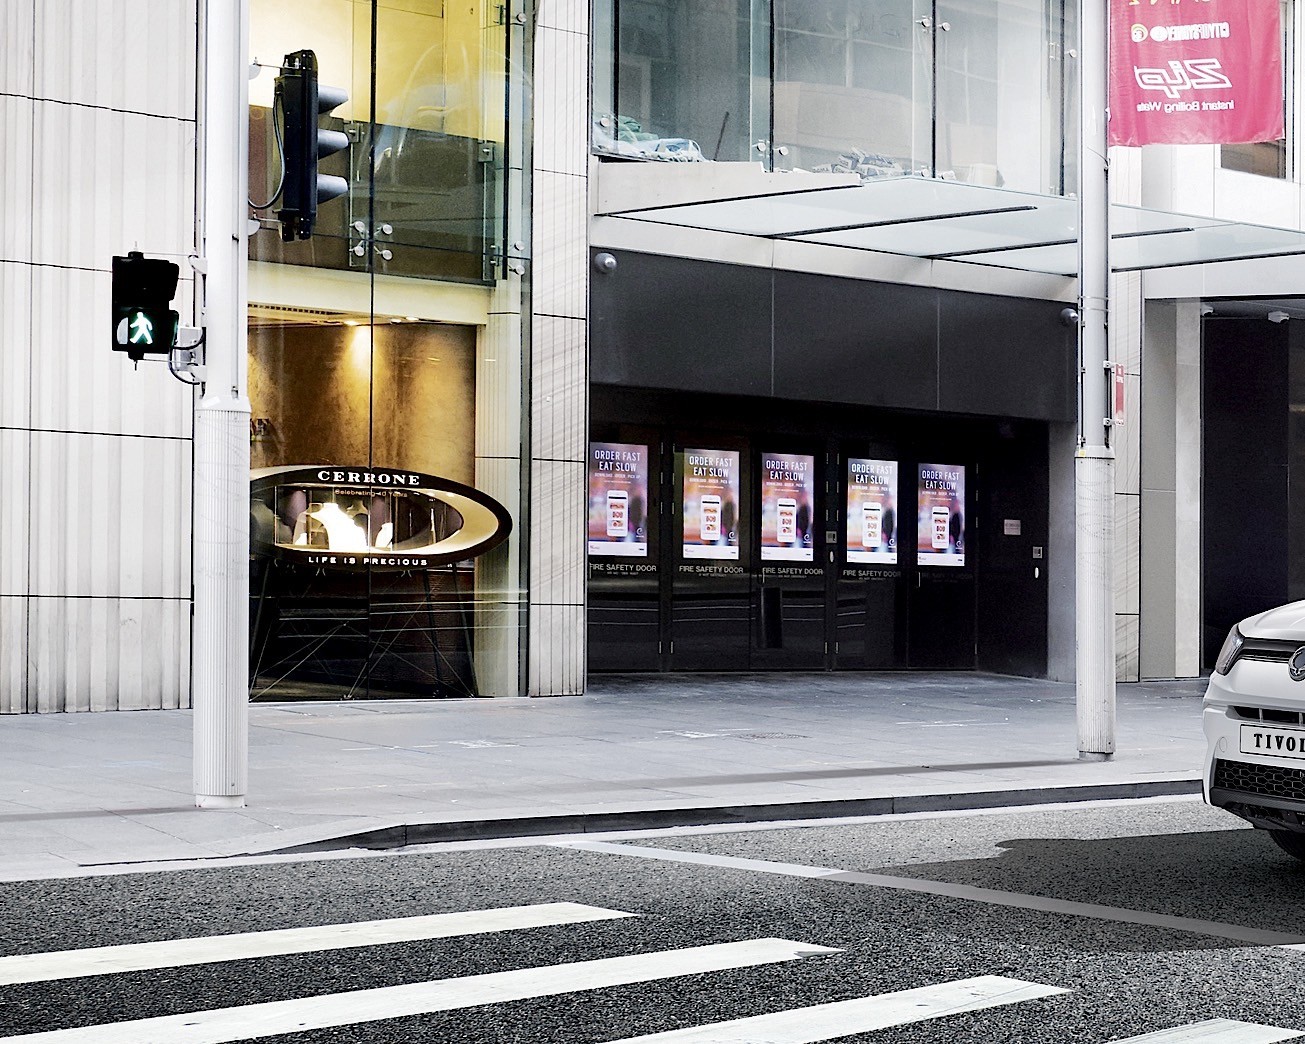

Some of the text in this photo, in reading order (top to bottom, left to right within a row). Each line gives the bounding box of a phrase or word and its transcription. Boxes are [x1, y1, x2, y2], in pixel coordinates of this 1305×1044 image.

[595, 450, 641, 461] ORDER FAST
[599, 461, 637, 472] EAT SLOW
[689, 456, 733, 467] ORDER FAST
[766, 460, 807, 471] ORDER FAST
[693, 467, 729, 477] EAT SLOW
[851, 463, 893, 475] ORDER FAST
[318, 470, 420, 485] CERRONE
[770, 471, 804, 481] EAT SLOW
[855, 474, 890, 485] EAT SLOW
[922, 470, 960, 481] ORDER FAST
[925, 480, 957, 490] EAT SLOW
[334, 489, 376, 497] Celebrating
[308, 556, 337, 564] LIFE
[364, 557, 428, 566] PRECIOUS
[606, 563, 634, 571] SAFETY
[635, 564, 657, 572] DOOR
[695, 565, 722, 573] SAFETY
[723, 566, 744, 574] DOOR
[778, 567, 803, 575] SAFETY
[858, 569, 881, 577] SAFETY
